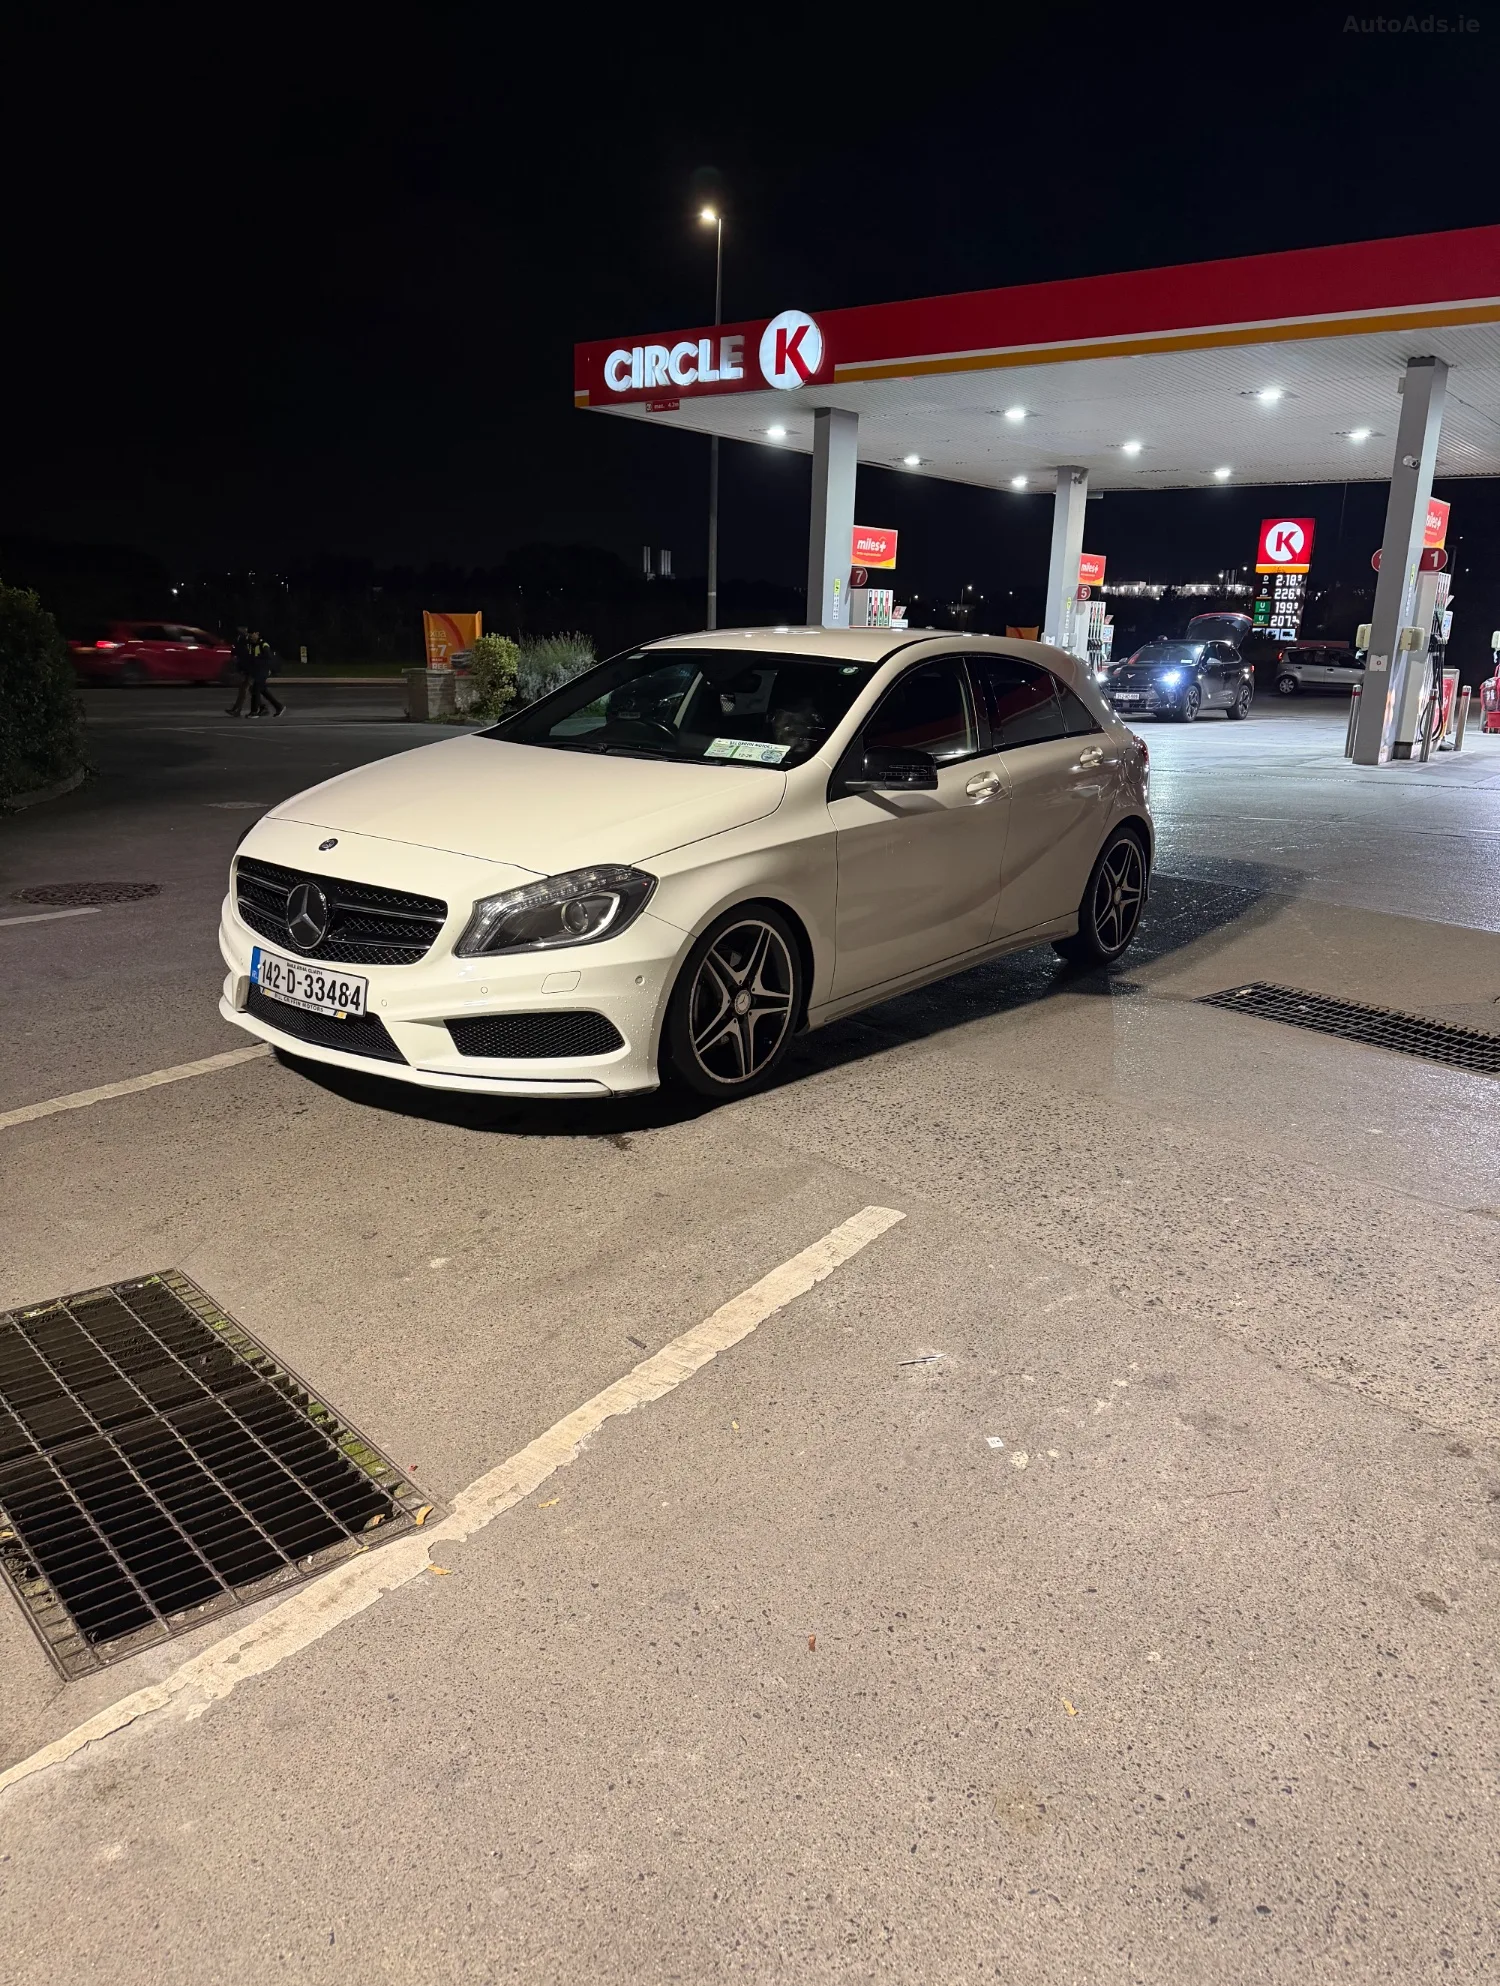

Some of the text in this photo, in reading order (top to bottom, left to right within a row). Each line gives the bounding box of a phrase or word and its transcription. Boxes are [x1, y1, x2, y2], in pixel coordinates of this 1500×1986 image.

[604, 325, 814, 393] CIRCLE K
[1275, 531, 1299, 557] K
[1430, 551, 1439, 567] 1
[856, 570, 864, 584] 7
[1081, 588, 1087, 598] 5
[1275, 601, 1299, 614] 199.9
[262, 959, 361, 1012] 142-D-33484
